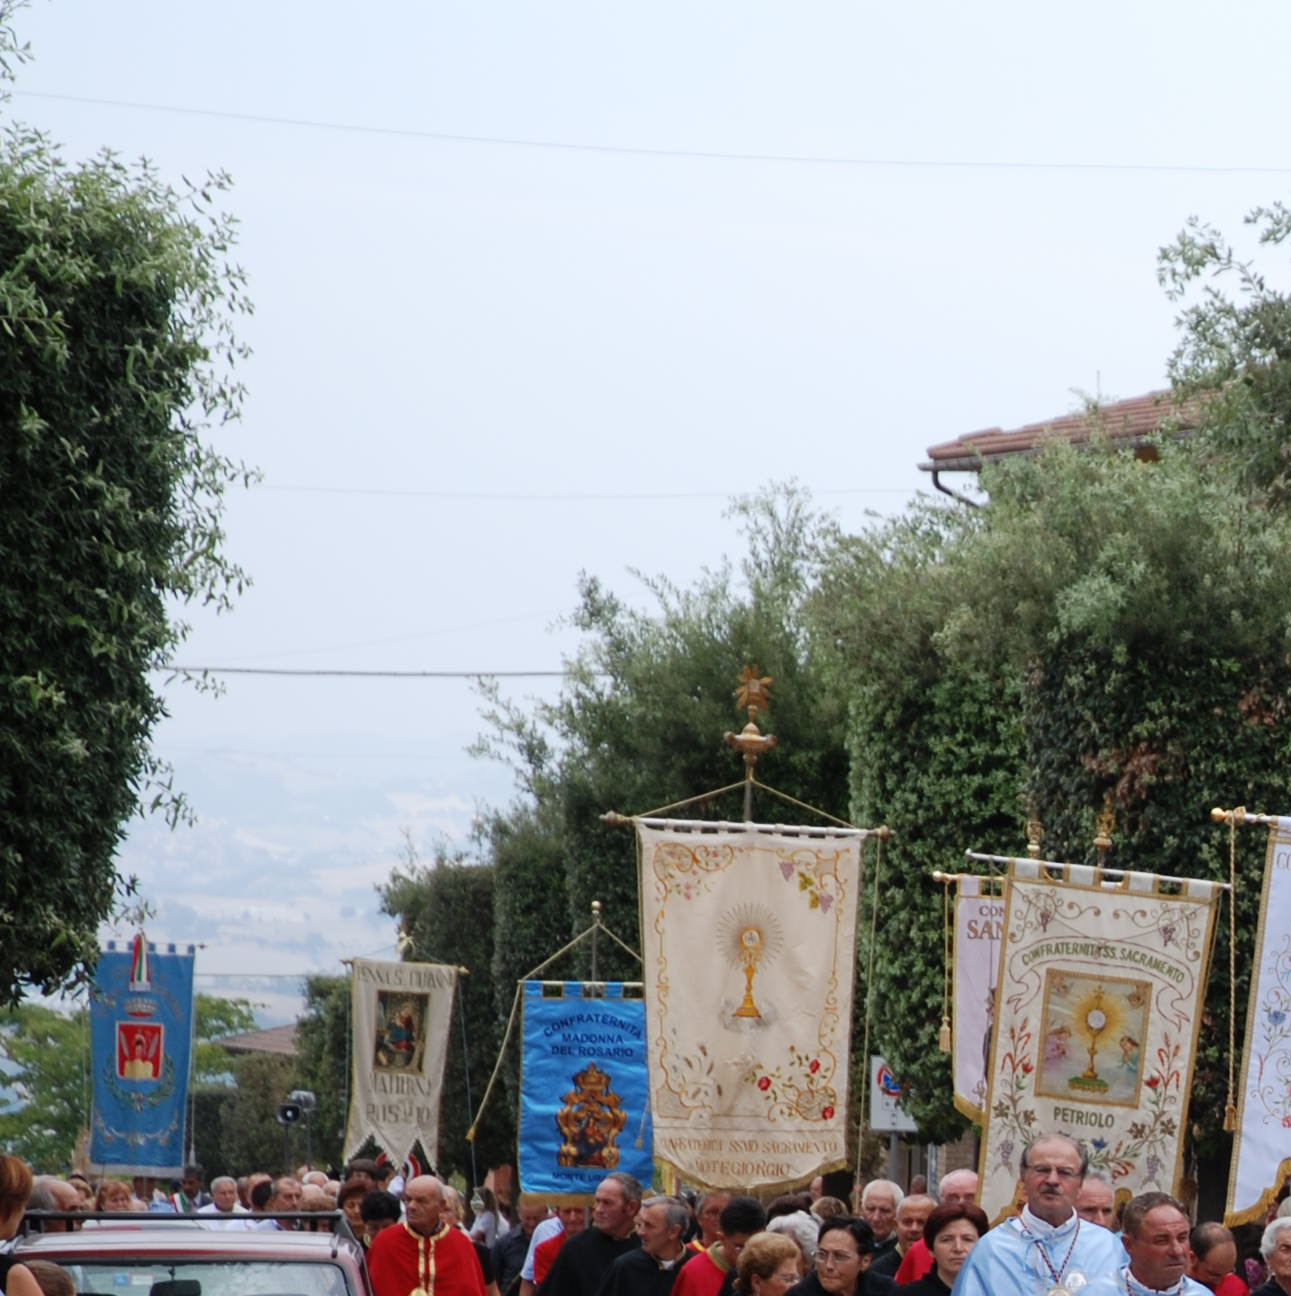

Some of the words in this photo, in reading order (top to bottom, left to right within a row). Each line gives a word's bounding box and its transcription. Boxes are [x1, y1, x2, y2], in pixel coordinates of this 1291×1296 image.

[1119, 948, 1185, 984] SACRAMENTO
[543, 1013, 642, 1039] CONFRATERNITA
[561, 1033, 624, 1044] MADONNA
[551, 1046, 573, 1057] DEL
[578, 1046, 634, 1058] ROSARIO
[1053, 1106, 1115, 1128] PETRIOLO
